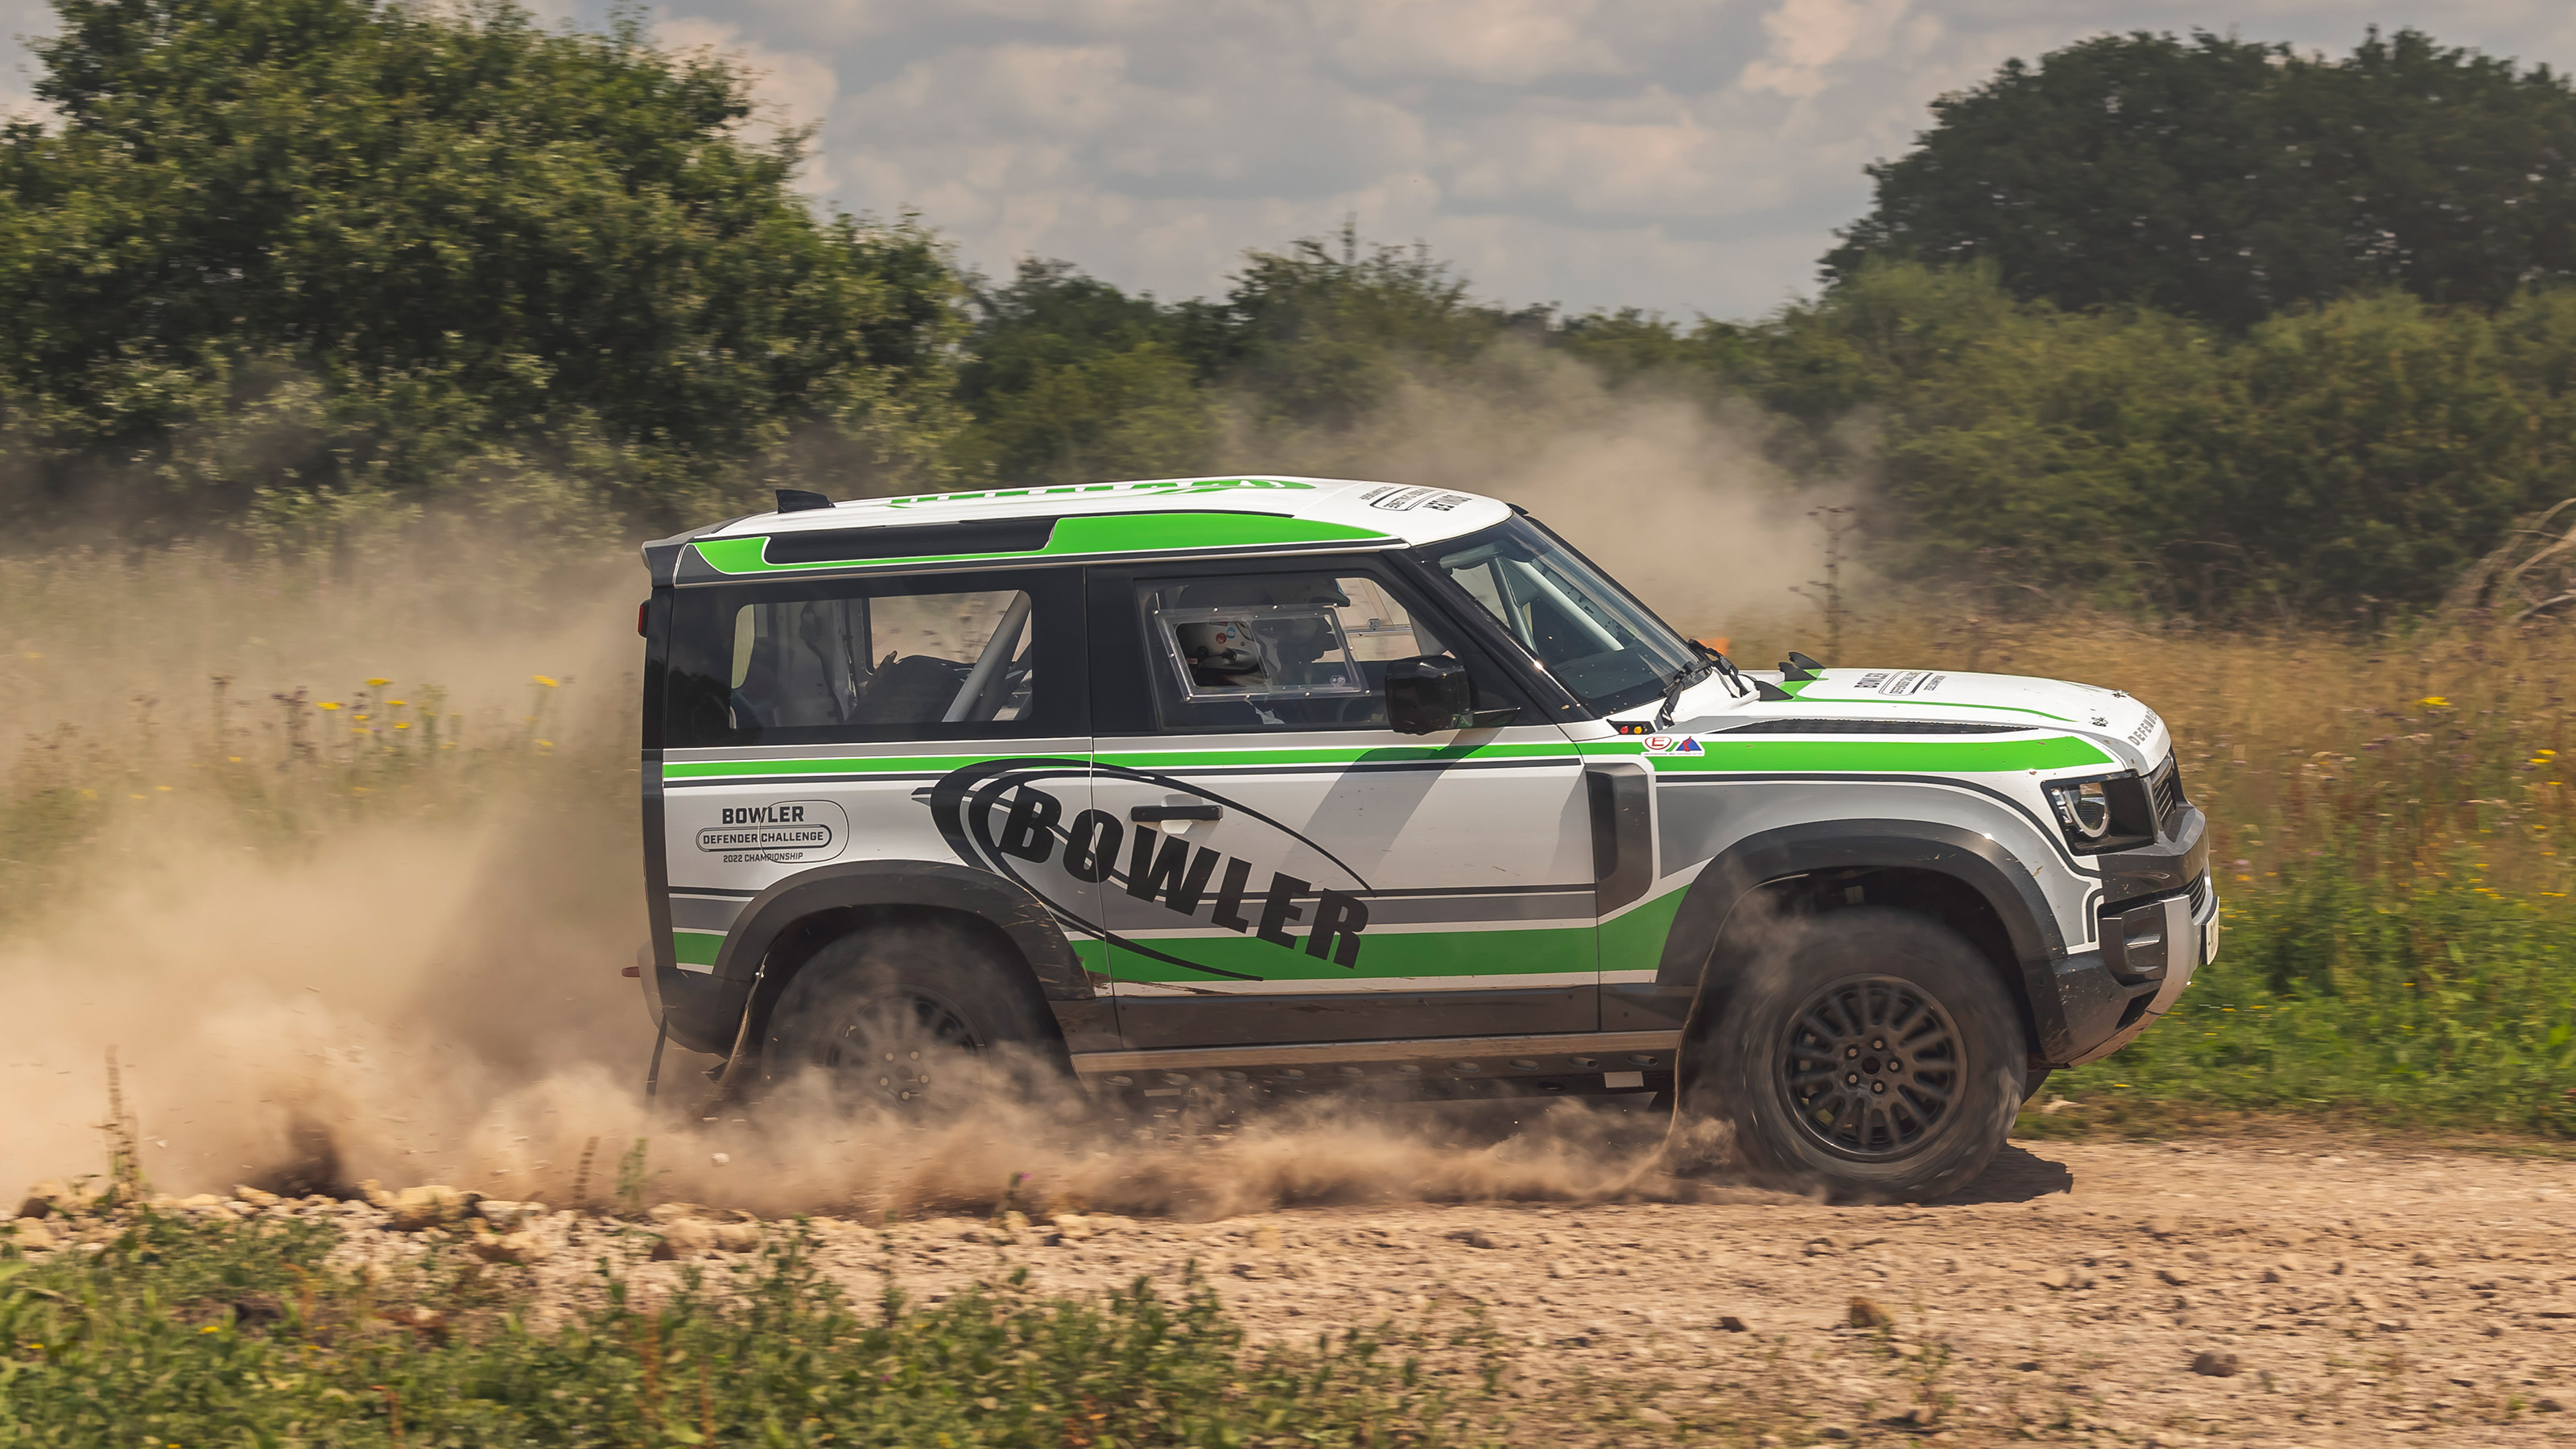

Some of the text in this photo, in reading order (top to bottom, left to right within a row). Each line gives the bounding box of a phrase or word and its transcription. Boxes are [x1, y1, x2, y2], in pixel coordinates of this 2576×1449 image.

[722, 806, 804, 824] BOWLER
[703, 832, 824, 844] DEFENDER CHALLENGE
[723, 852, 803, 863] 2022 CHAMPIONSHIP
[999, 784, 1369, 969] BOWLER
